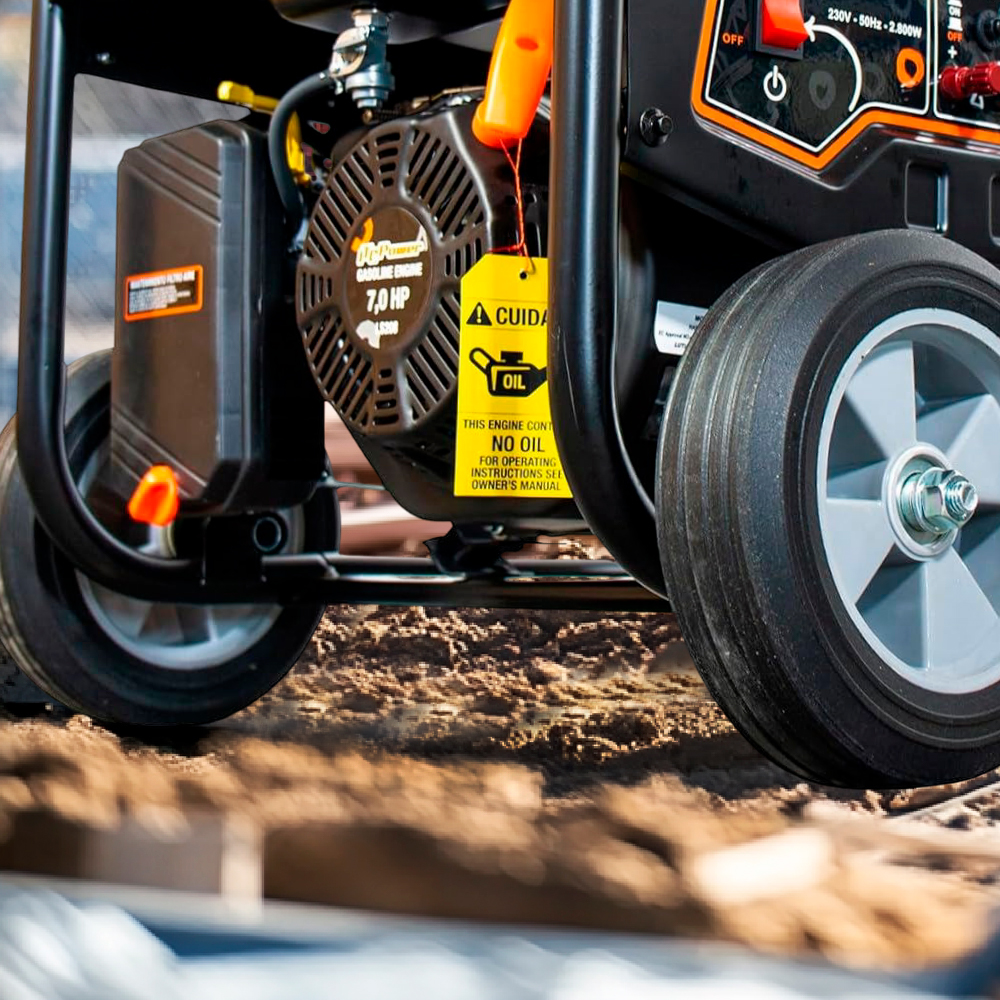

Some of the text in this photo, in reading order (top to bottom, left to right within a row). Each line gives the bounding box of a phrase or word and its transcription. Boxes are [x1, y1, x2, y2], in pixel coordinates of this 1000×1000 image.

[948, 5, 961, 18] ON
[827, 6, 852, 24] 230V
[858, 13, 883, 31] 50Hz
[888, 20, 923, 39] 2.800W
[722, 32, 744, 46] OFF
[947, 30, 963, 42] OFF
[356, 261, 423, 282] GASOLINE ENGINE
[366, 285, 411, 316] 7,0 HP
[503, 373, 526, 390] OIL
[463, 419, 486, 430] THIS
[488, 419, 524, 431] ENGINE
[492, 435, 545, 453] NO OIL
[479, 455, 557, 468] FOR OPERATING
[471, 467, 543, 480] INSTRUCTIONS
[471, 479, 562, 492] OWNER'S MANUAL
